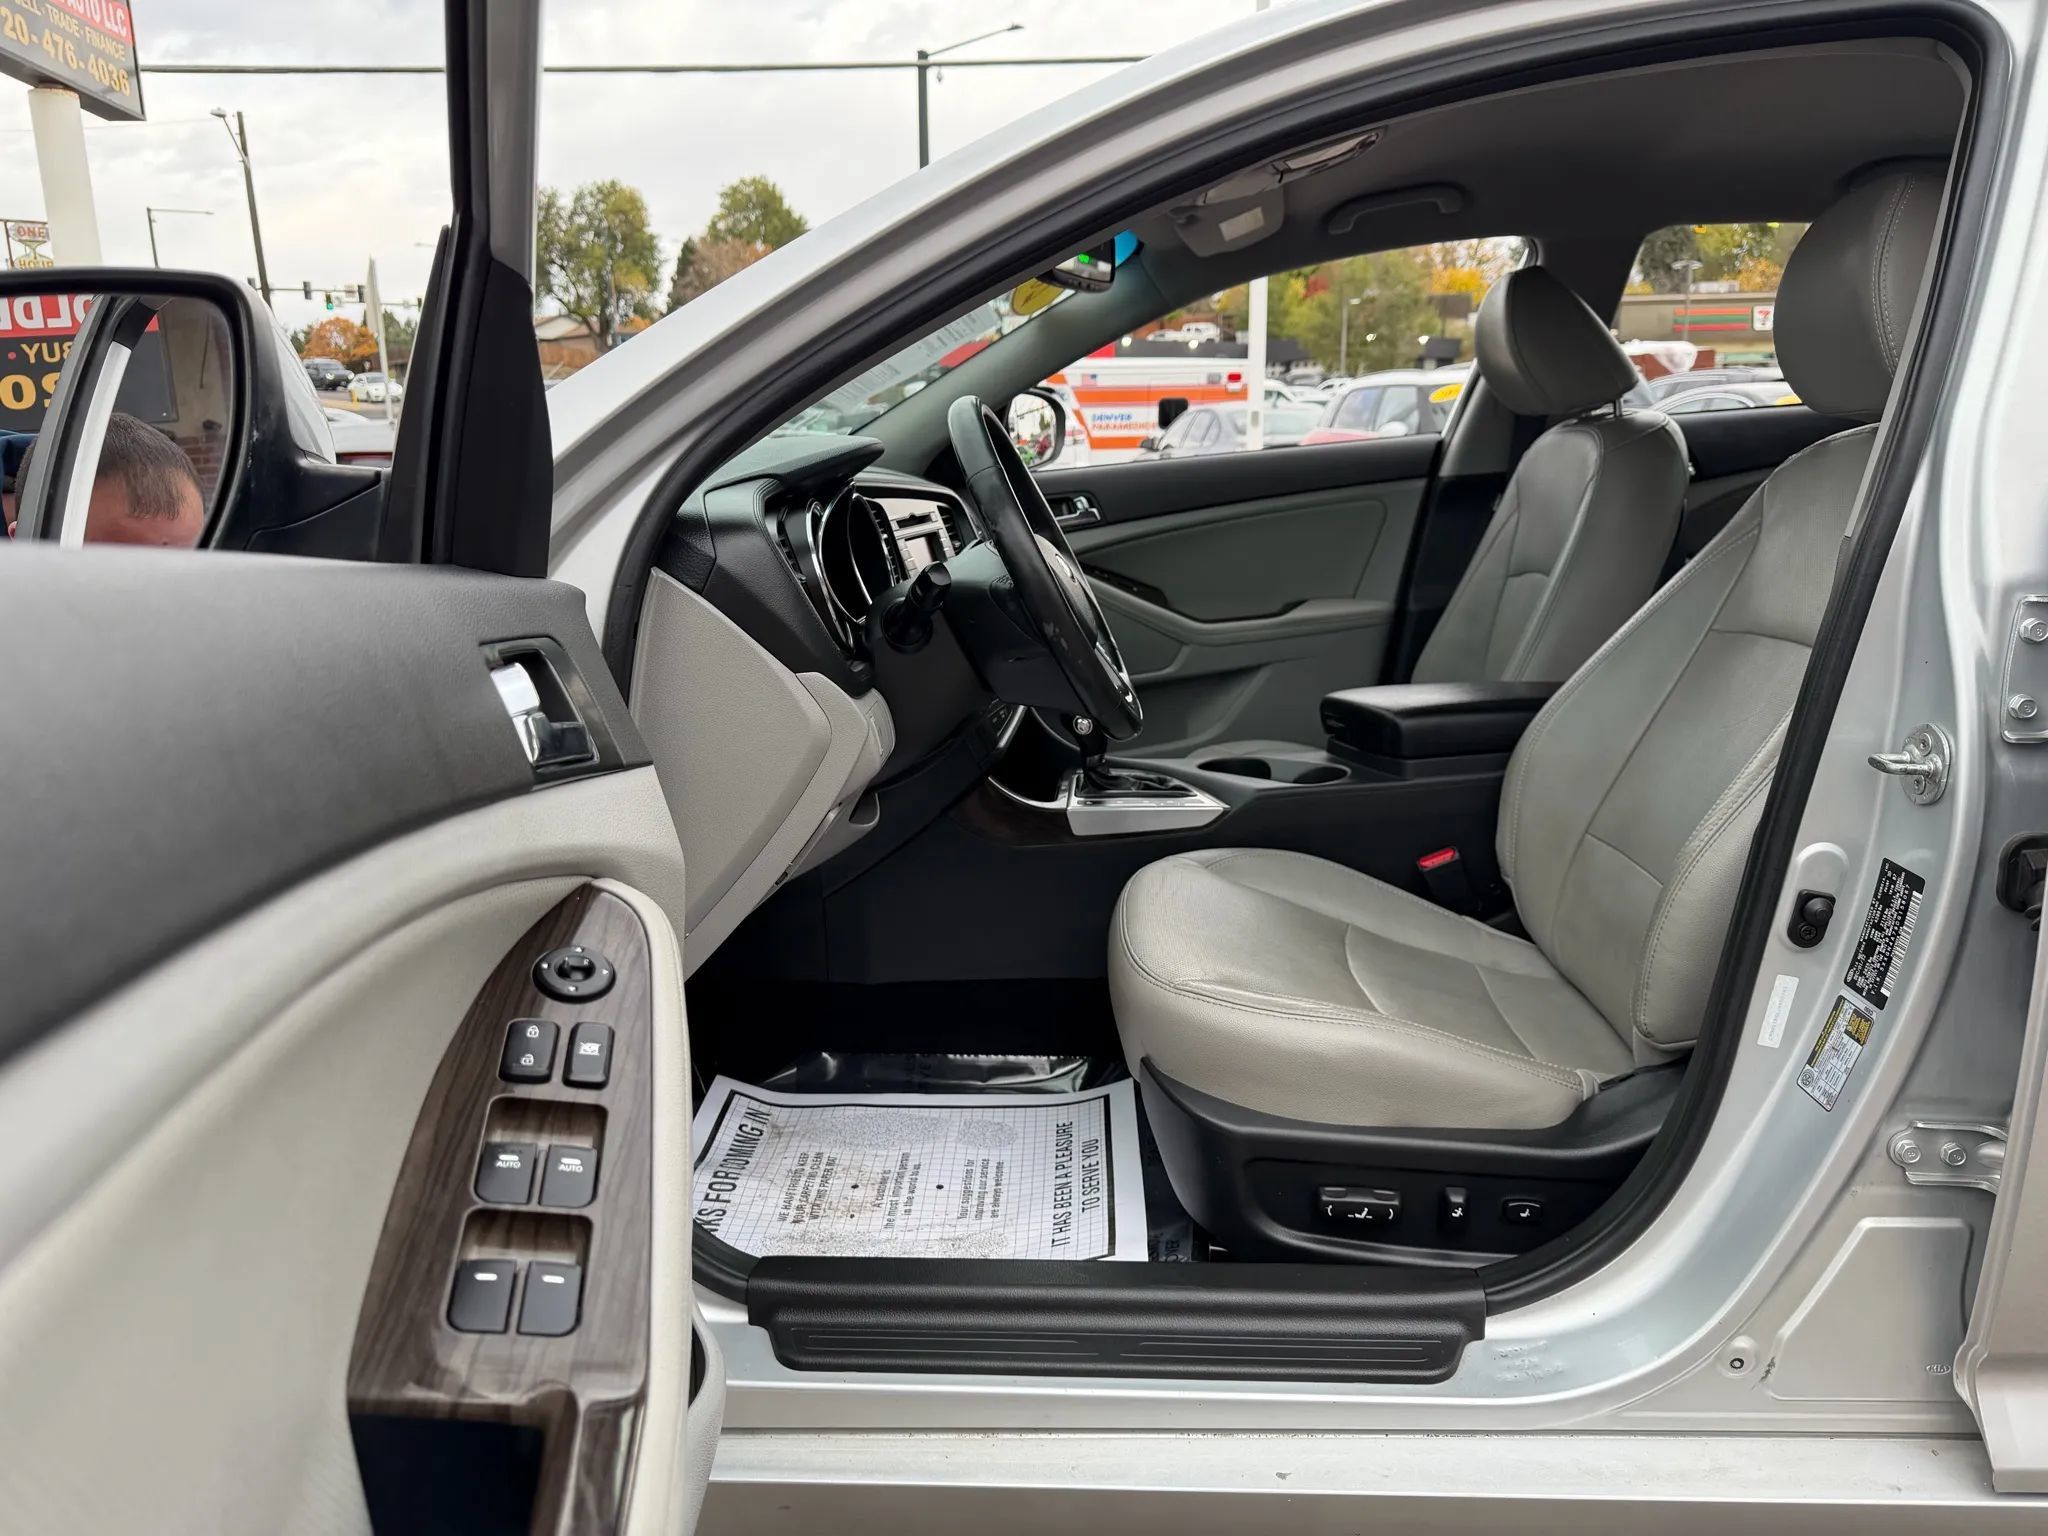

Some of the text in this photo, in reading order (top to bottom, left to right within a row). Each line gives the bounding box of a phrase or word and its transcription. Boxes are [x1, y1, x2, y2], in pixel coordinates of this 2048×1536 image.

[45, 3, 80, 37] TRADE
[85, 26, 125, 61] FINANCE
[101, 0, 127, 37] LLC
[16, 226, 46, 238] ONE
[743, 1107, 771, 1125] IN
[718, 1124, 764, 1170] COMING
[496, 1161, 583, 1172] AUTO AUTO
[1081, 1138, 1100, 1213] TO SERVE YOU
[703, 1170, 741, 1204] FOR
[1051, 1121, 1073, 1248] IT HAS BEEN A PLEASURE
[882, 1218, 895, 1229] the
[957, 1205, 969, 1220] Your
